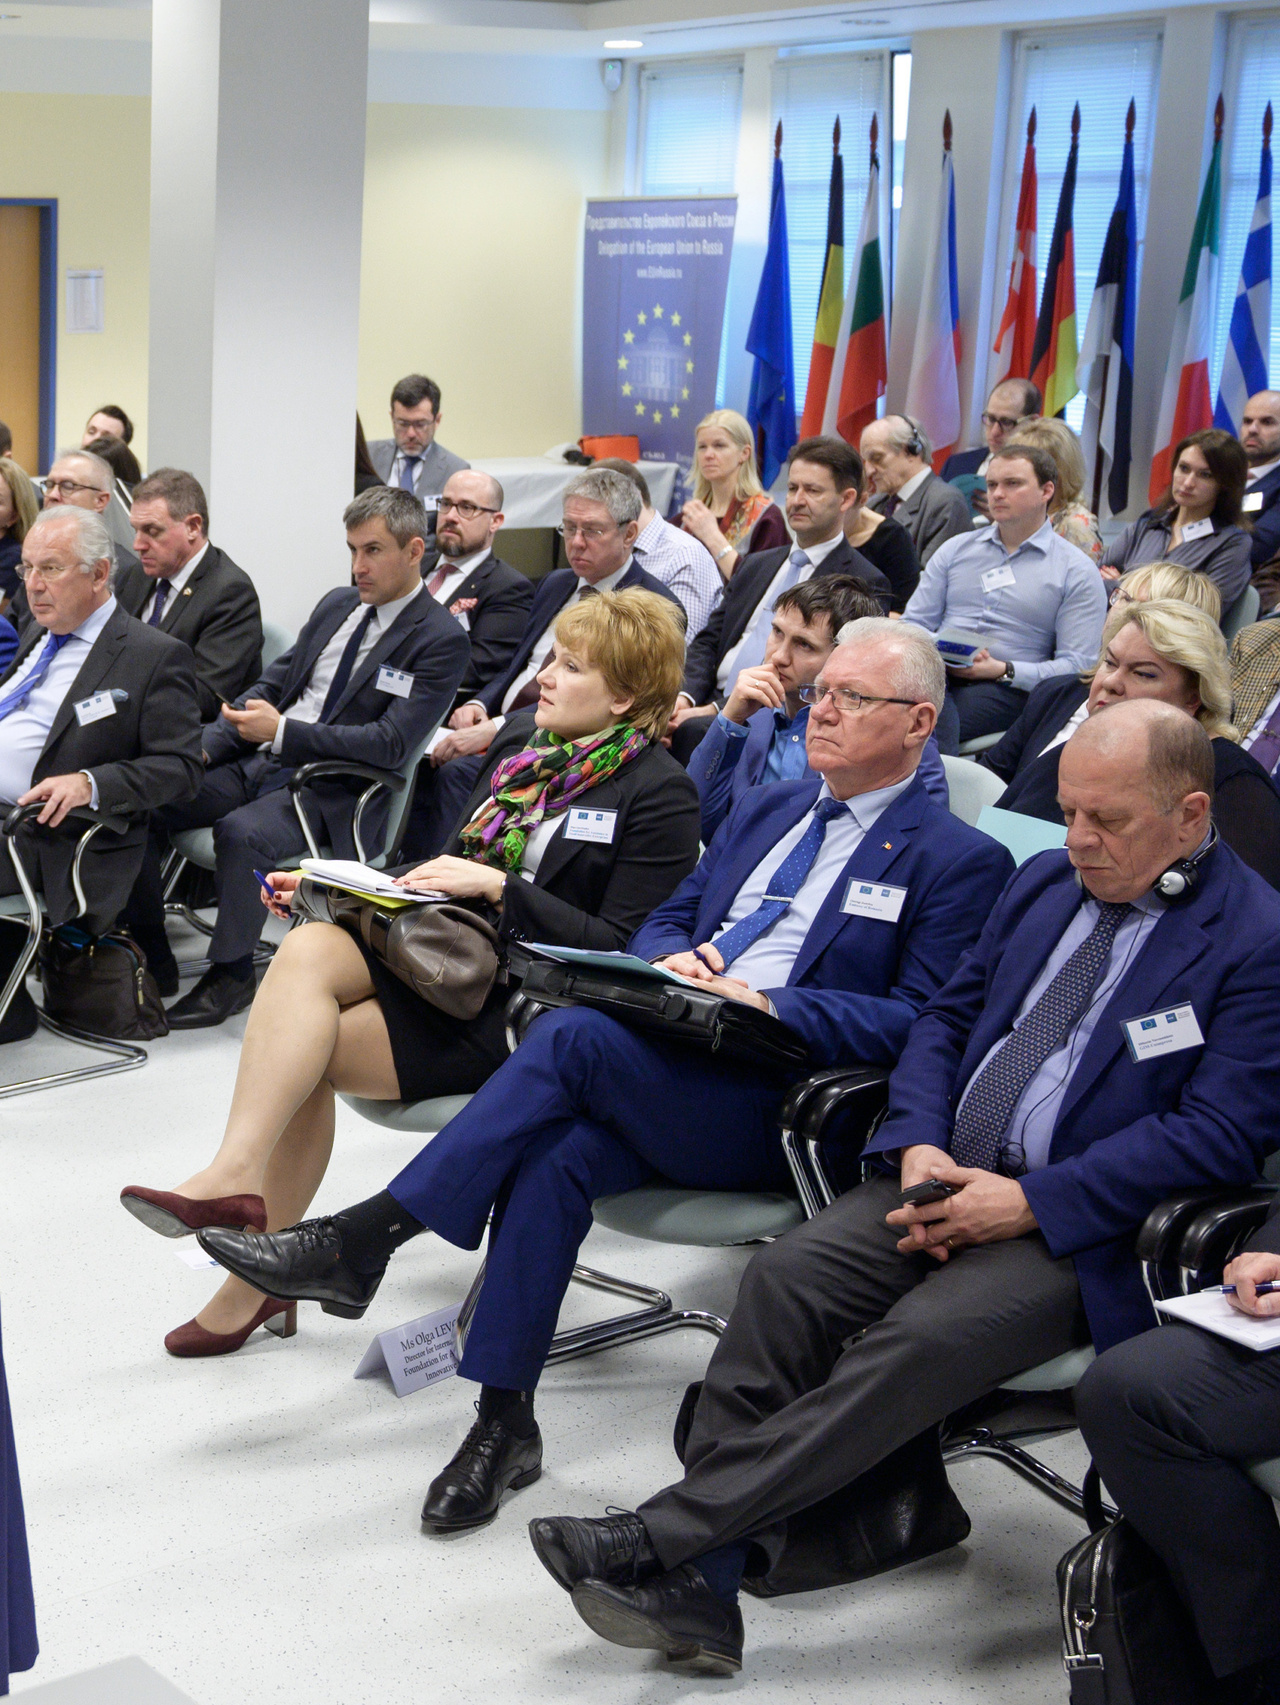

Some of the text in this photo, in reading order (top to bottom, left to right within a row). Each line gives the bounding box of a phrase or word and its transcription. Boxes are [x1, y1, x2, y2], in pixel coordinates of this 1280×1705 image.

[686, 212, 706, 228] Союза
[712, 211, 735, 228] России
[598, 239, 723, 257] Delegation of the European Union to Russia
[400, 1339, 415, 1352] Ms
[415, 1332, 435, 1346] Olga
[404, 1350, 426, 1364] Director
[425, 1346, 435, 1355] for
[403, 1358, 439, 1377] Foundation
[438, 1352, 449, 1362] for
[425, 1362, 458, 1381] Innovative
